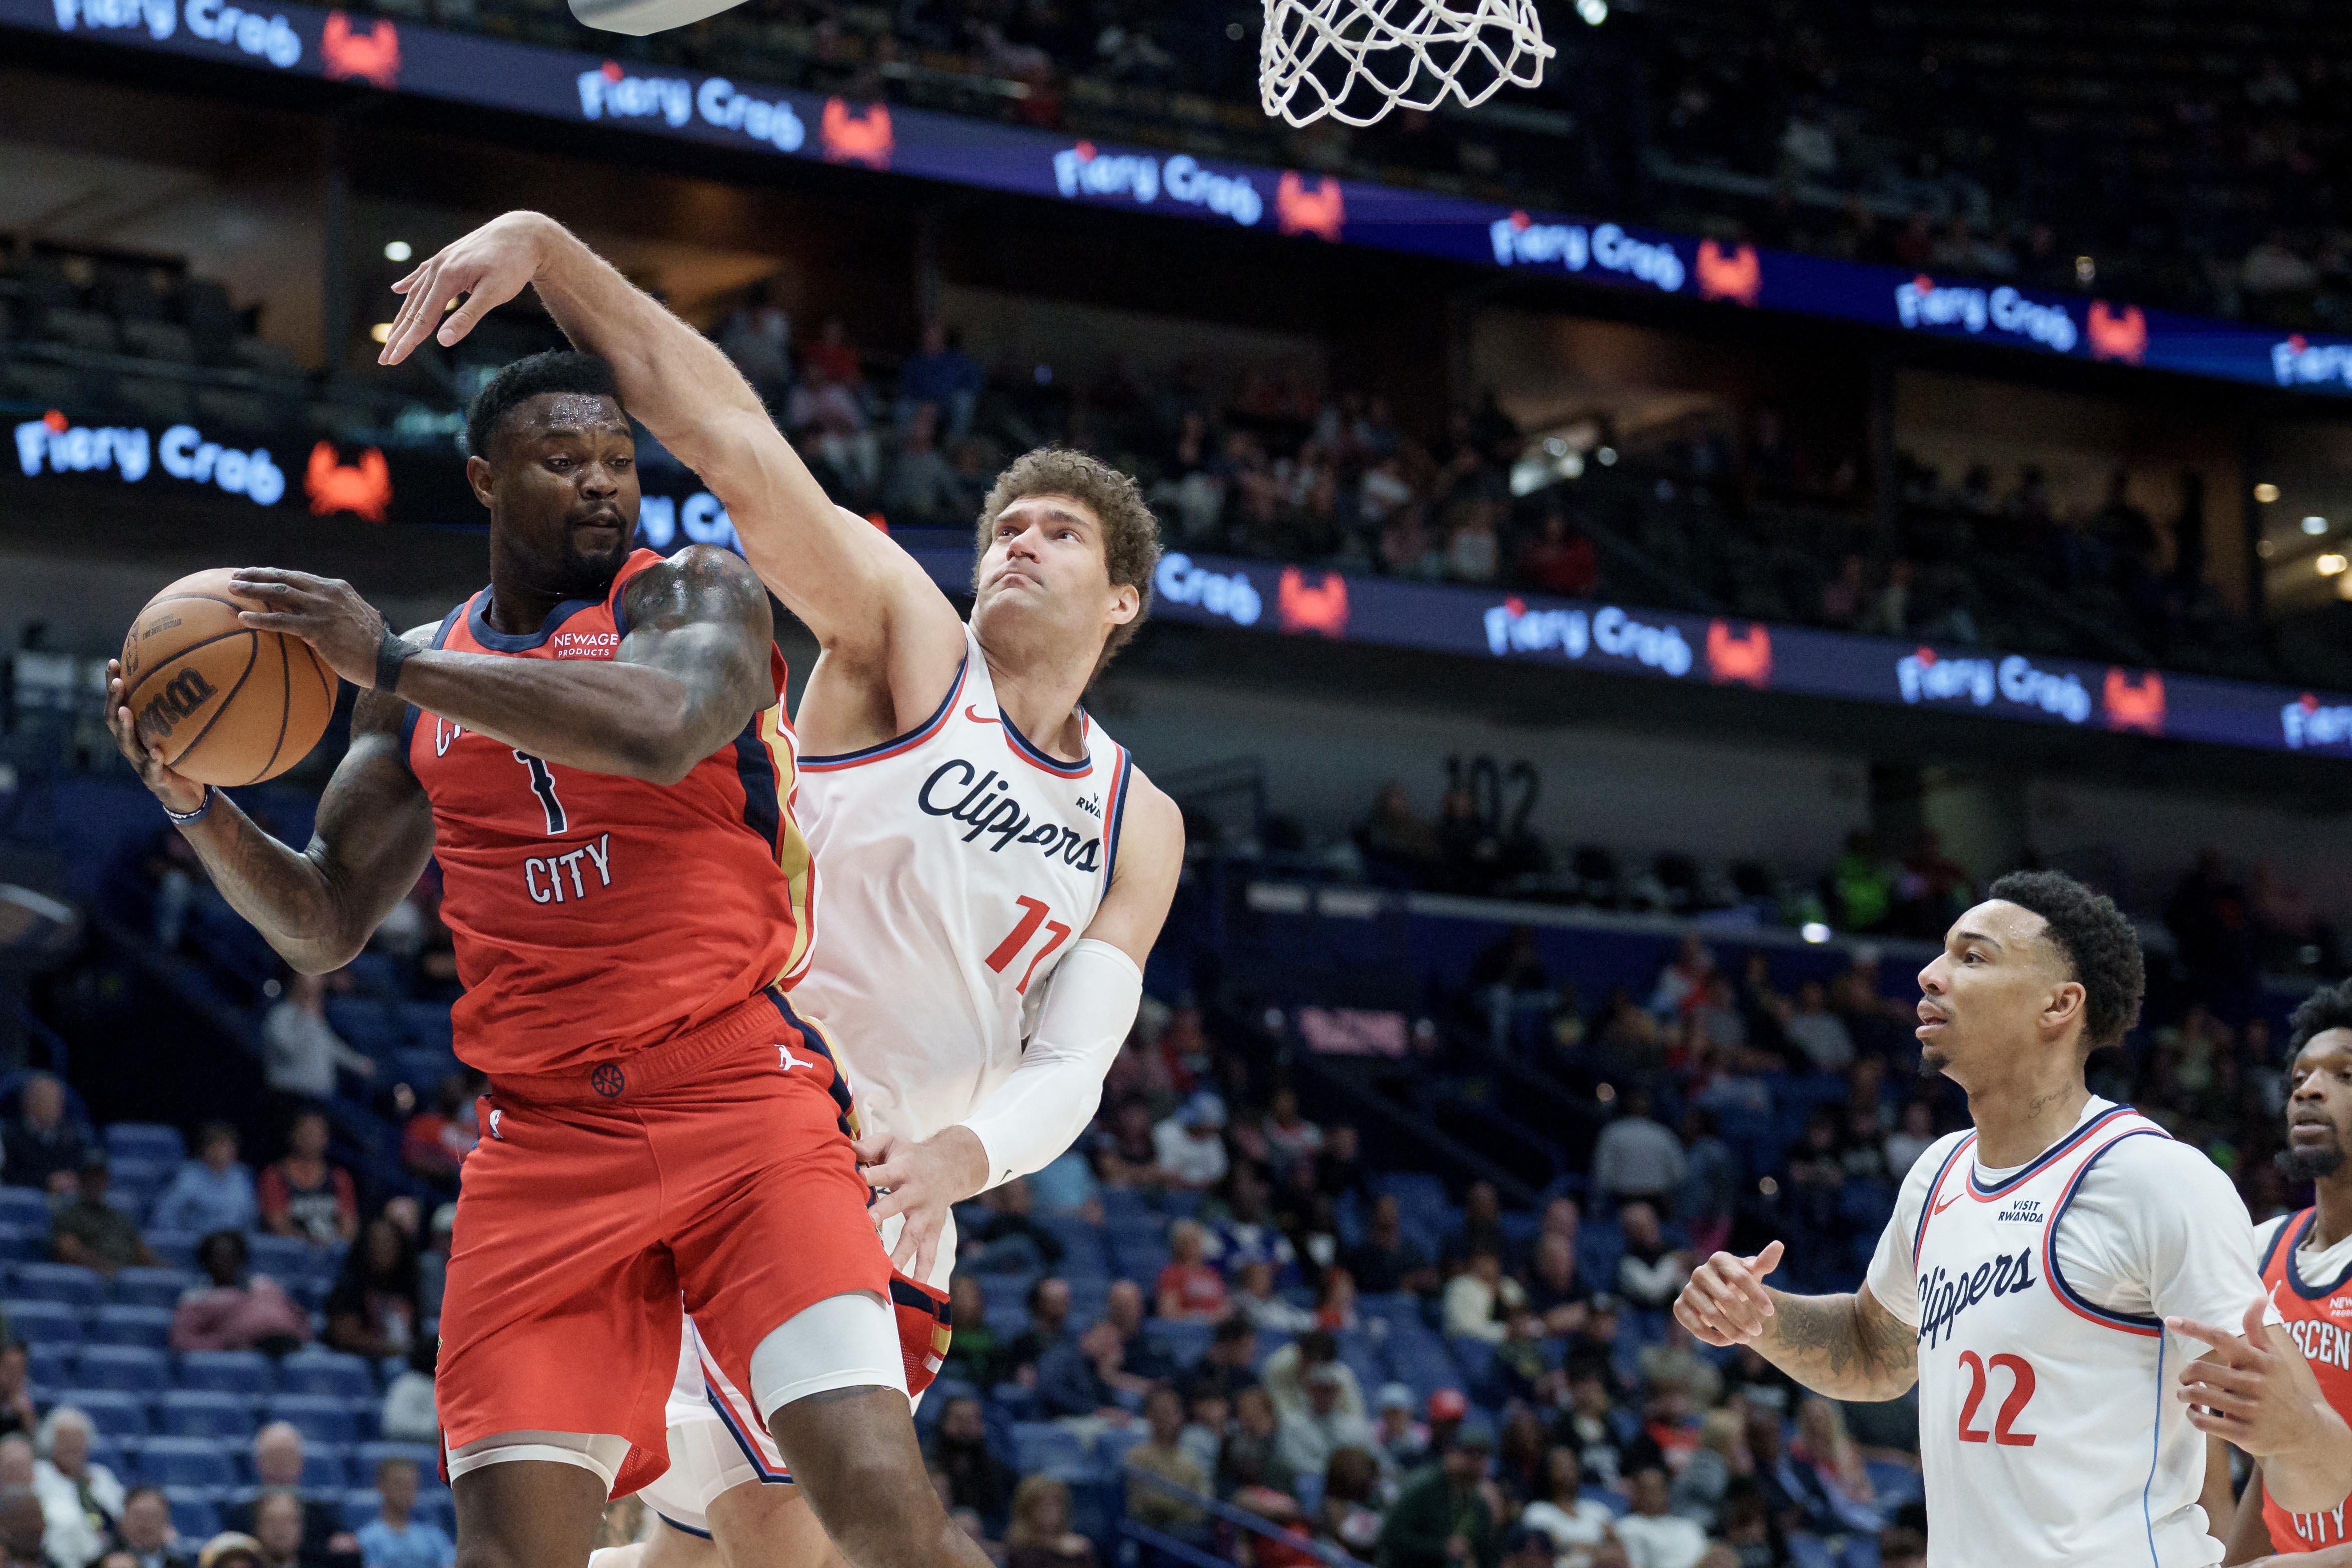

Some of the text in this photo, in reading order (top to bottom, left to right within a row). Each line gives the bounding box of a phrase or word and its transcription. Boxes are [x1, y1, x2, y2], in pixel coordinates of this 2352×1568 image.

[577, 60, 805, 152] Fiery Crab
[1053, 141, 1263, 225] Fiery Crab
[1490, 210, 1684, 291] Fiery Crab
[1895, 274, 2077, 351] Fiery Crab
[2271, 334, 2352, 387] Fier
[15, 410, 285, 505] Fiery Crab
[1155, 552, 1262, 625] Crab
[554, 633, 619, 648] NEWAGE
[558, 648, 610, 658] PRODUCTS
[1483, 595, 1692, 677] Fiery Crab
[1896, 646, 2091, 723] Fiery Crab
[513, 748, 568, 835] 1
[918, 759, 1100, 872] Clippers
[525, 833, 612, 904] CITY
[984, 895, 1071, 995] 11
[1998, 1211, 2043, 1223] RWANDA
[2013, 1200, 2041, 1211] VISIT
[1959, 1350, 2036, 1446] 22
